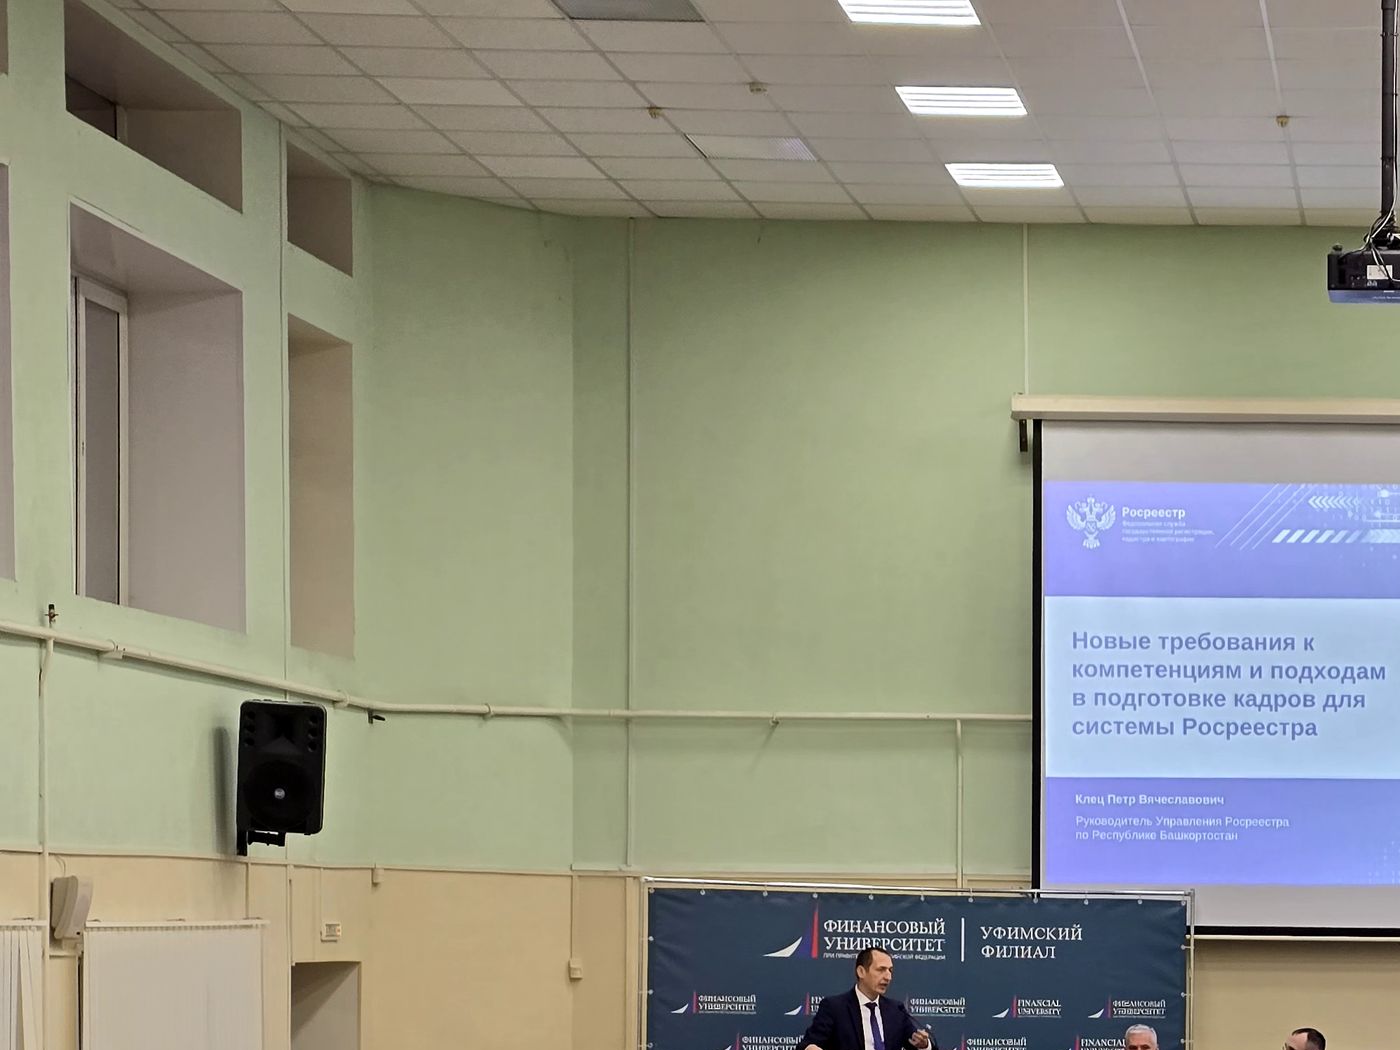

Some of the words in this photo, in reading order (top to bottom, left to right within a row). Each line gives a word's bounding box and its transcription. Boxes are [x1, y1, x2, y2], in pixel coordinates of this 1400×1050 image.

[1122, 506, 1186, 520] Росреестр
[1072, 631, 1151, 650] Новые
[1158, 632, 1296, 654] требования
[1303, 635, 1315, 651] к
[1072, 662, 1242, 682] компетенциям
[1250, 664, 1262, 680] и
[1270, 664, 1386, 684] подходам
[1072, 691, 1086, 706] в
[1094, 690, 1227, 711] подготовке
[1234, 692, 1316, 713] кадров
[1322, 693, 1366, 712] для
[1072, 719, 1175, 736] системы
[1182, 718, 1318, 741] Росреестра
[1075, 794, 1105, 806] Клец
[1107, 794, 1136, 807] Петр
[1139, 794, 1225, 805] Вячеславович
[1075, 815, 1153, 827] Руководитель
[1156, 815, 1222, 827] Управления
[1225, 816, 1290, 828] Росреестра
[1075, 831, 1089, 840] по
[1092, 830, 1157, 842] Республике
[1160, 830, 1238, 842] Башкортостан
[823, 917, 946, 935] ФИНАНСОВЫЙ
[980, 923, 1082, 941] УФИМСКИЙ
[824, 936, 946, 952] УНИВЕРСИТЕТ
[981, 945, 1056, 959] ФИЛИАЛ
[1017, 999, 1061, 1007] FINANCIAL
